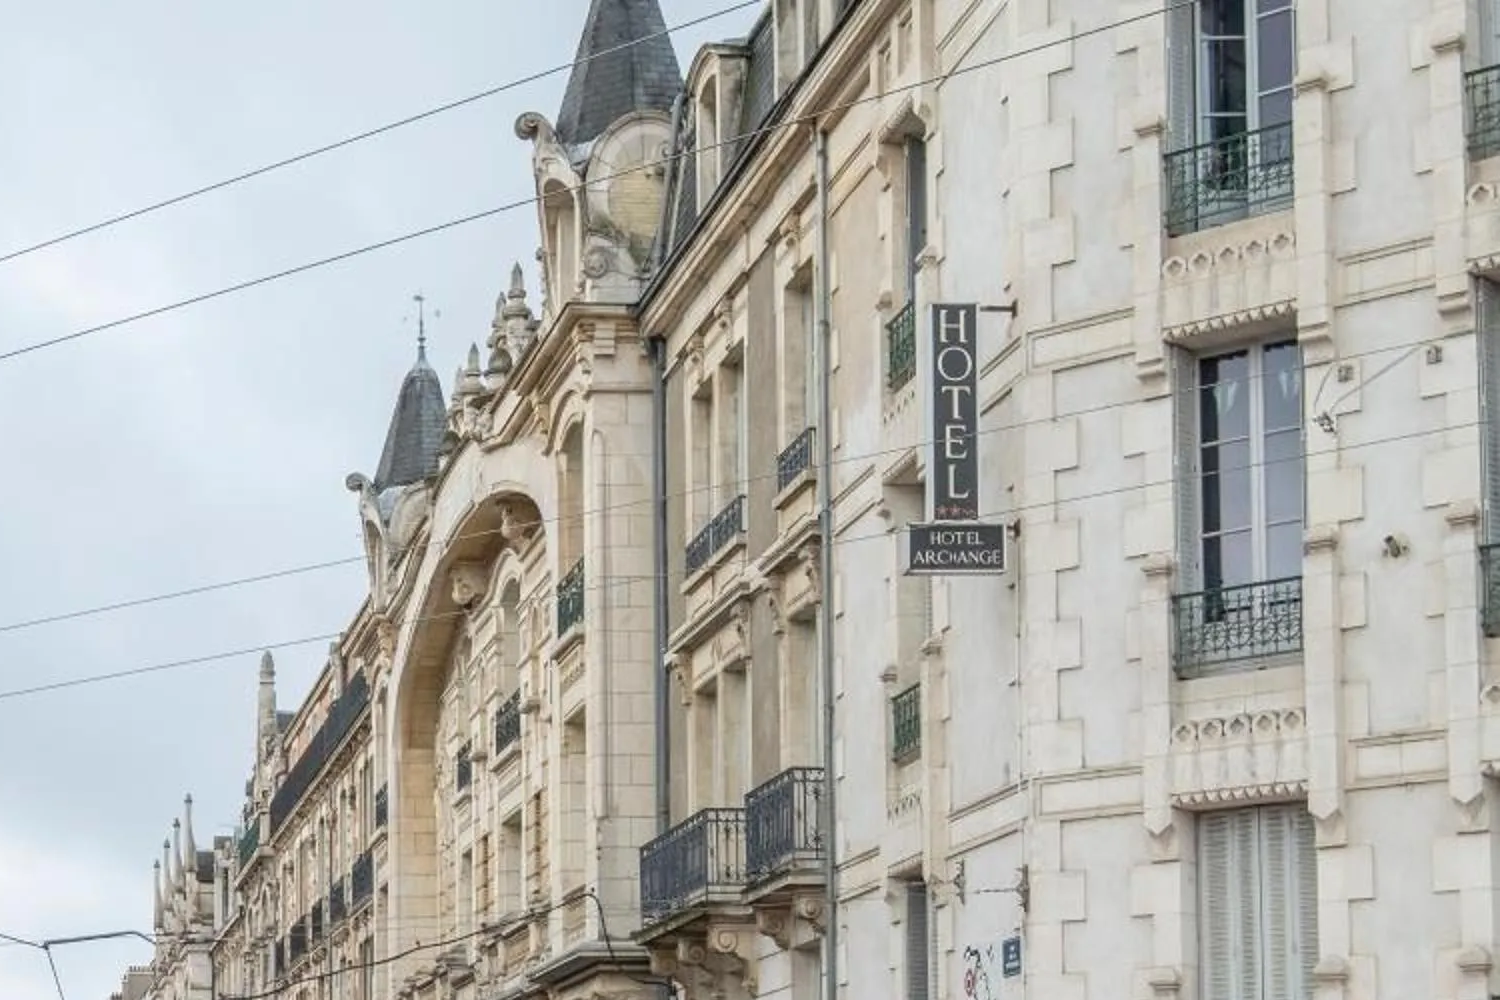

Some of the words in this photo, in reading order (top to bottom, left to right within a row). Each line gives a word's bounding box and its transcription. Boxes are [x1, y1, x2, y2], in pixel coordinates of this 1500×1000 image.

[937, 309, 973, 499] HOTEL
[930, 531, 984, 545] HOTEL
[913, 550, 1001, 565] ARCHANGE
